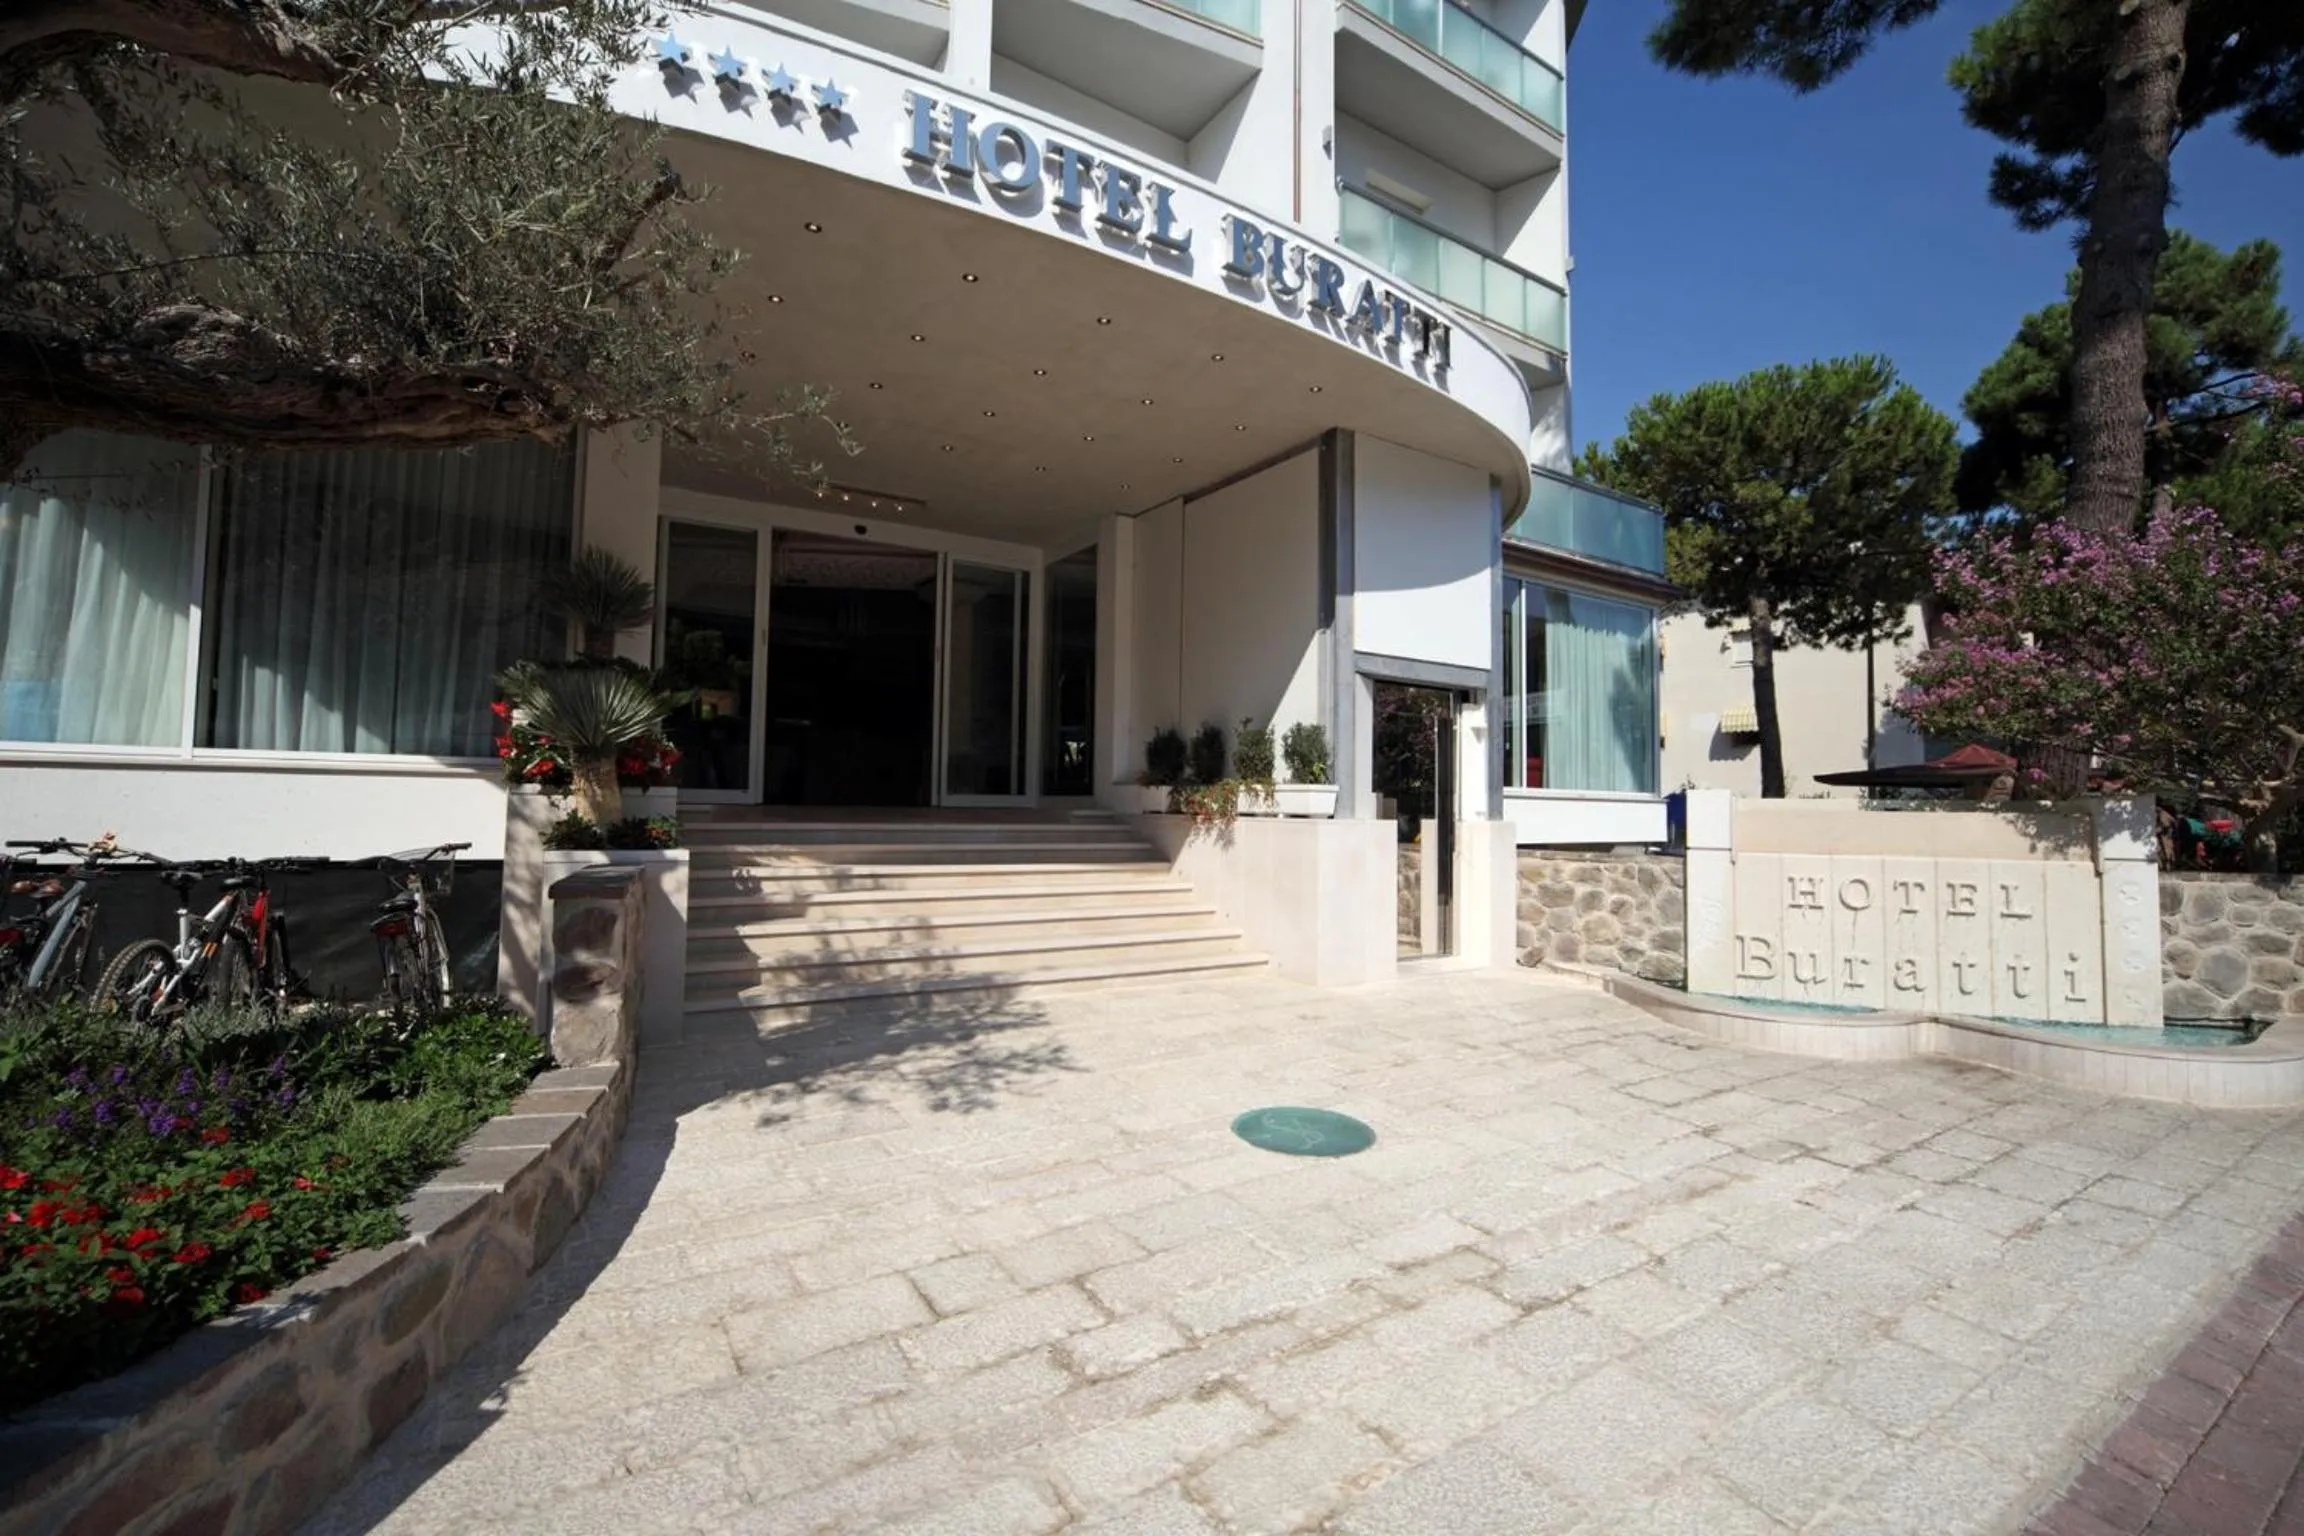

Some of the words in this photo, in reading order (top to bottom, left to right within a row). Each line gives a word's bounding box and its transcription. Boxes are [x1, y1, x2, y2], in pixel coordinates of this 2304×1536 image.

[902, 88, 1193, 253] HOTEL
[1220, 212, 1453, 370] BURATTI
[1787, 875, 2033, 919] HOTEL
[1734, 933, 2087, 1003] Buratti
